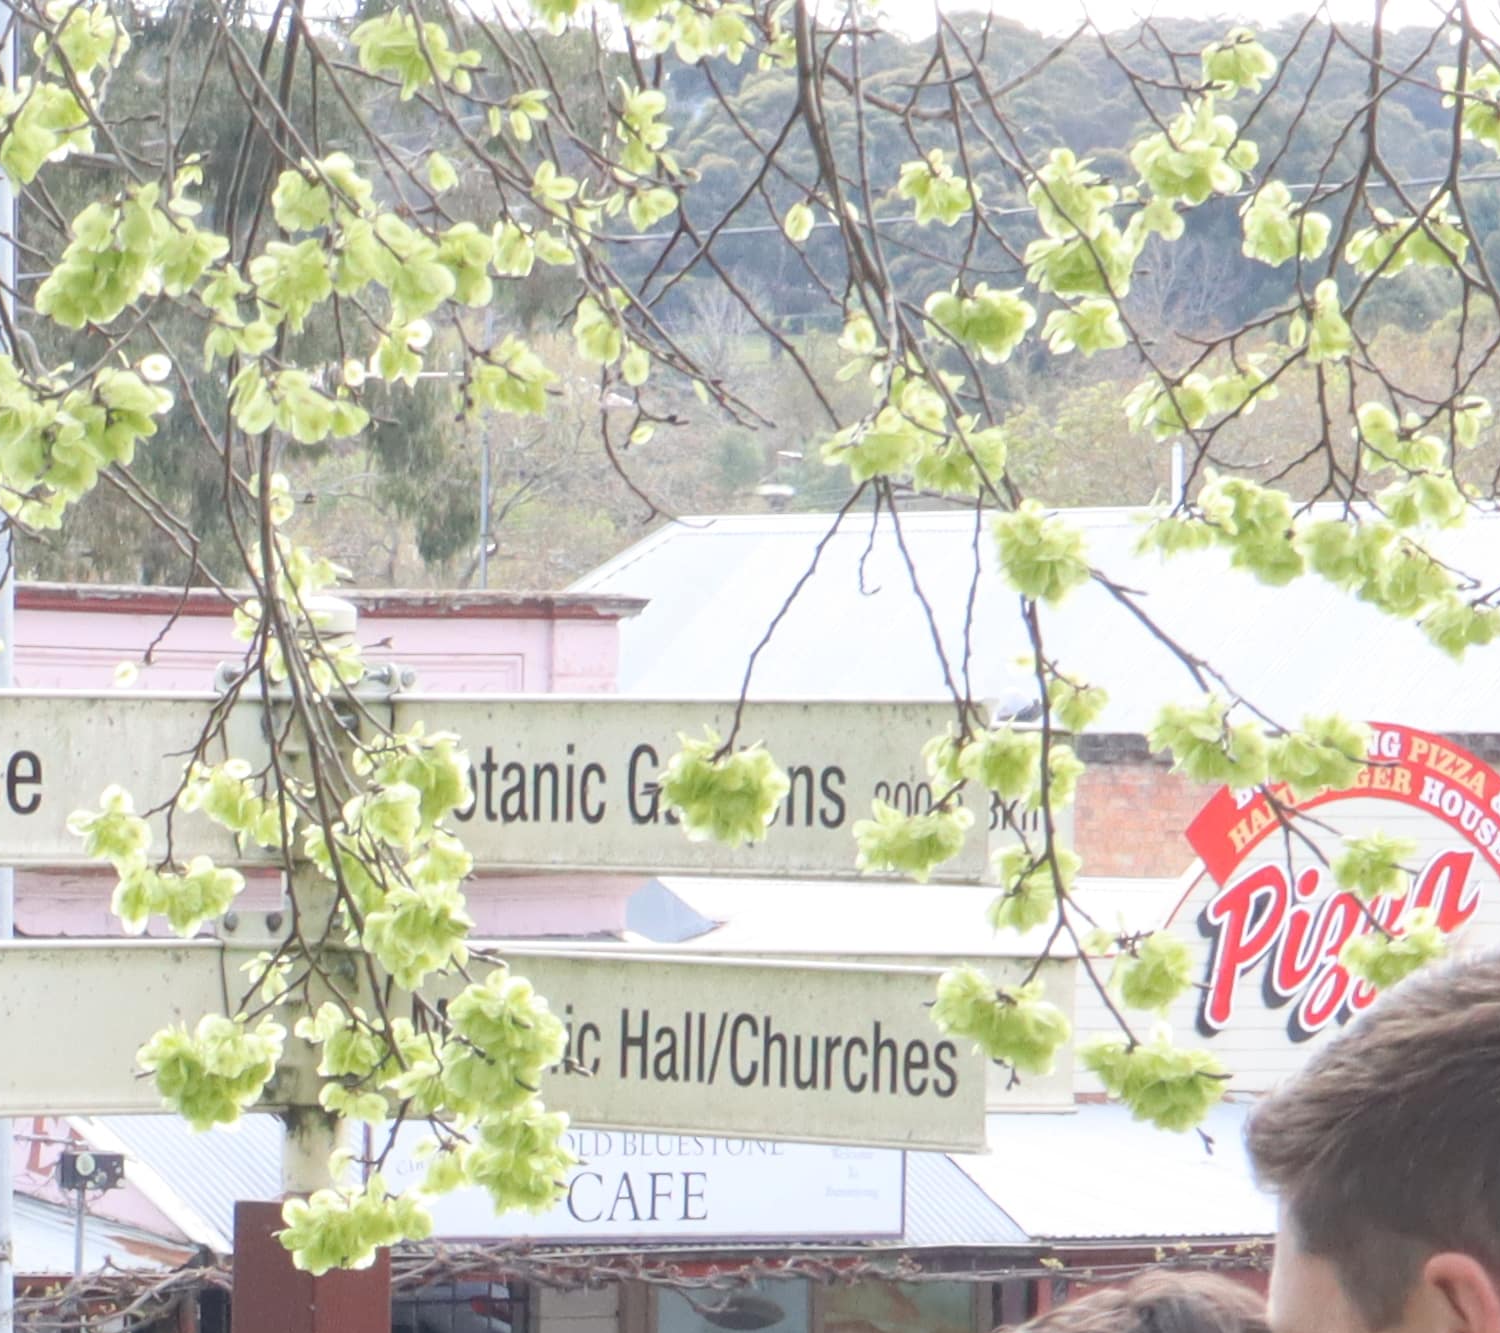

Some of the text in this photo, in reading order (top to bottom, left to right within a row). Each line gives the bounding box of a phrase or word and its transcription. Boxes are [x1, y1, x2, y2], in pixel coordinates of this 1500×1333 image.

[1407, 736, 1489, 799] PIZZA
[619, 1007, 959, 1099] Hall/Churches
[566, 1171, 709, 1224] CAFE
